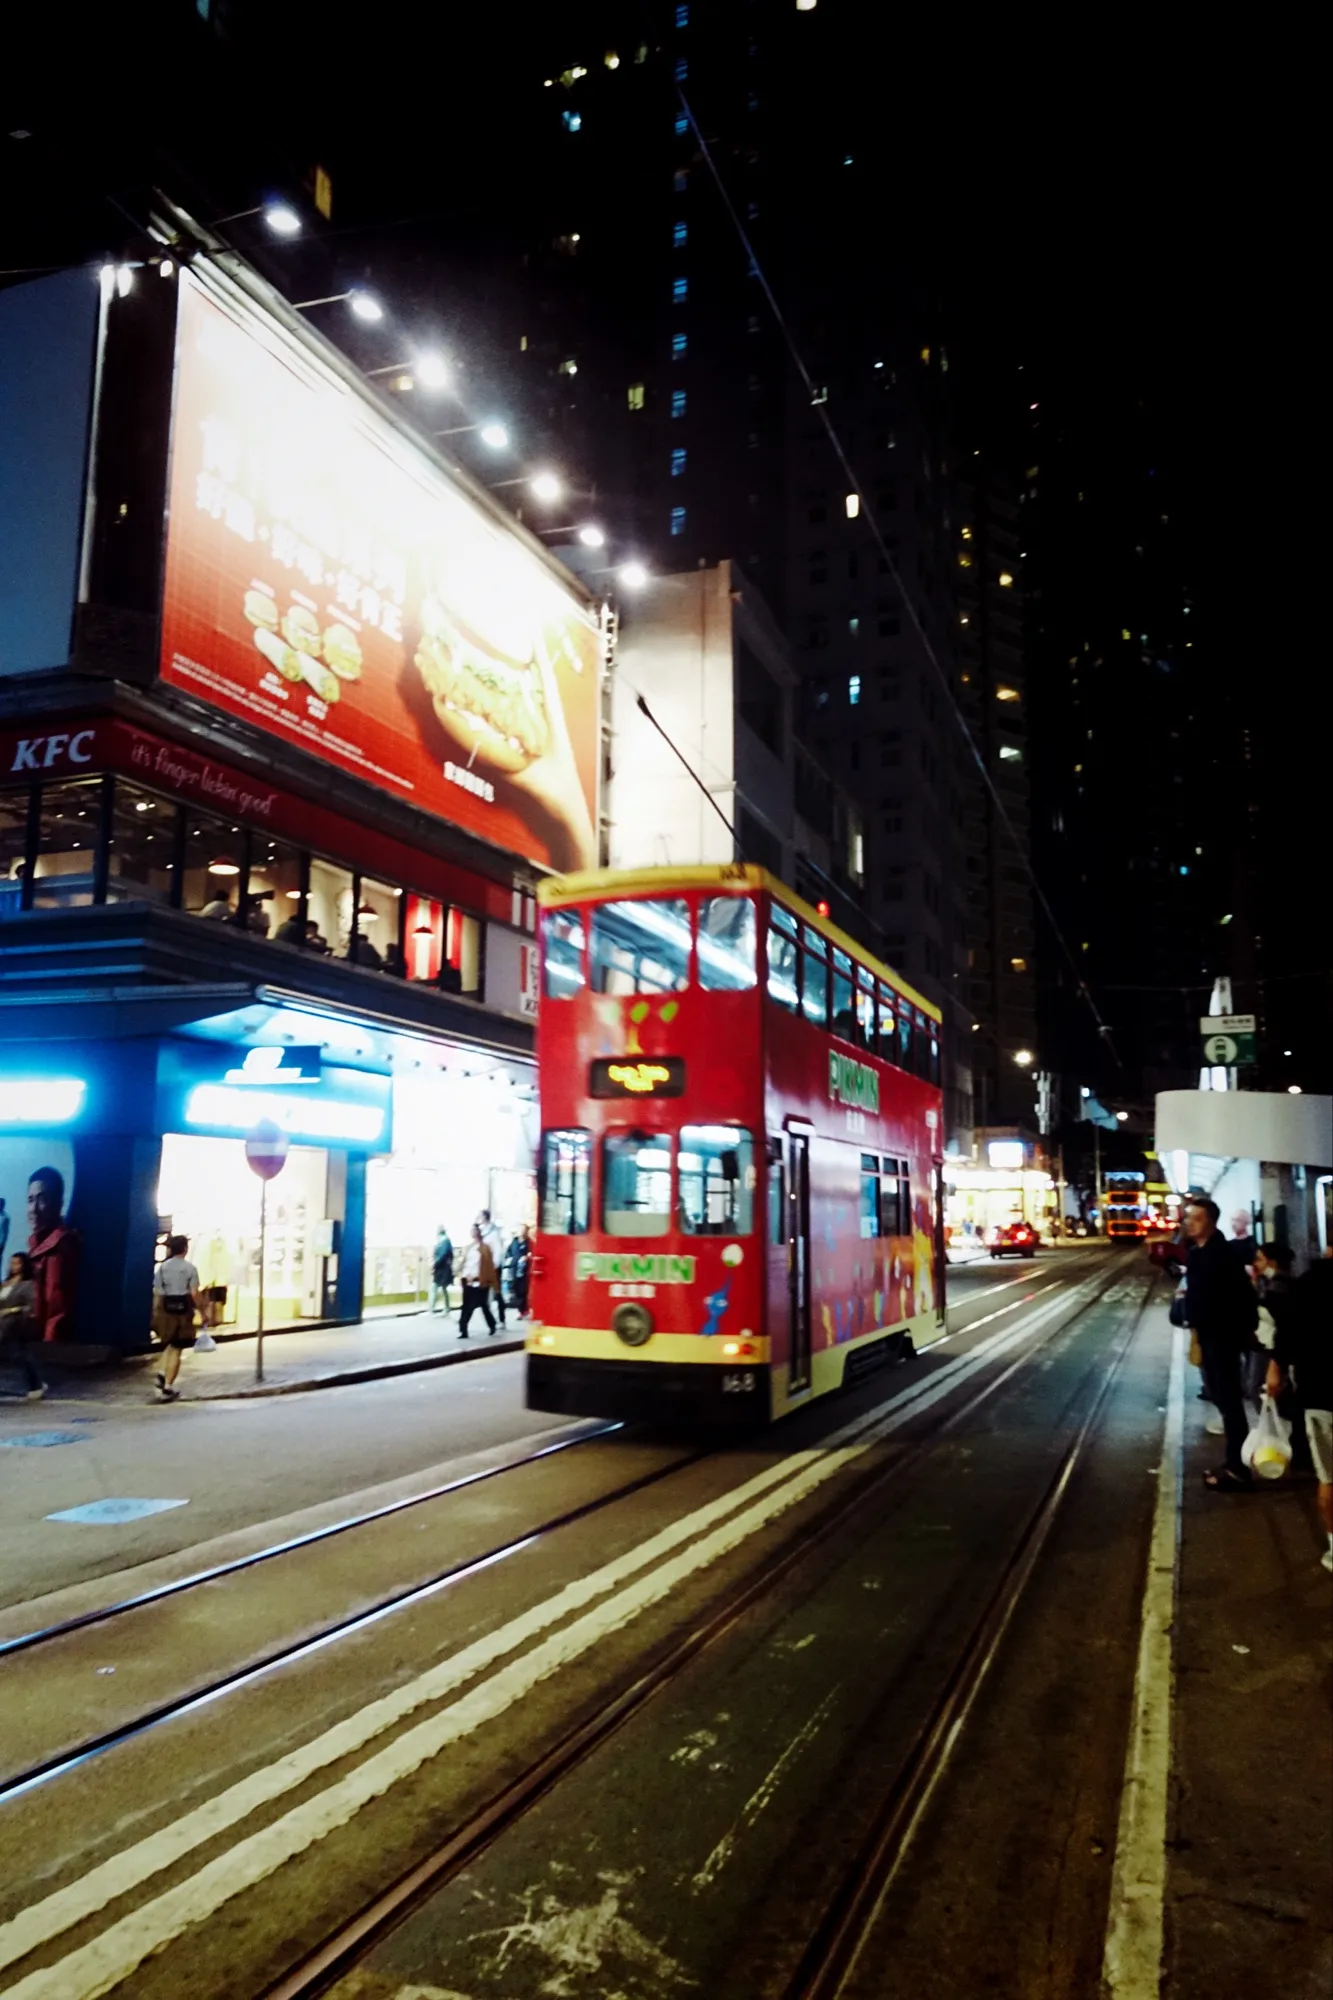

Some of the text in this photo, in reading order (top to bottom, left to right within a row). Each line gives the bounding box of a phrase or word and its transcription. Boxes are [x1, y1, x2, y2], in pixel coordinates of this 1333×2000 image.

[10, 730, 96, 771] KFC
[154, 747, 200, 788] finger
[828, 1048, 880, 1115] PIKMIN
[574, 1251, 697, 1284] PIKMIN
[722, 1372, 756, 1392] 168
